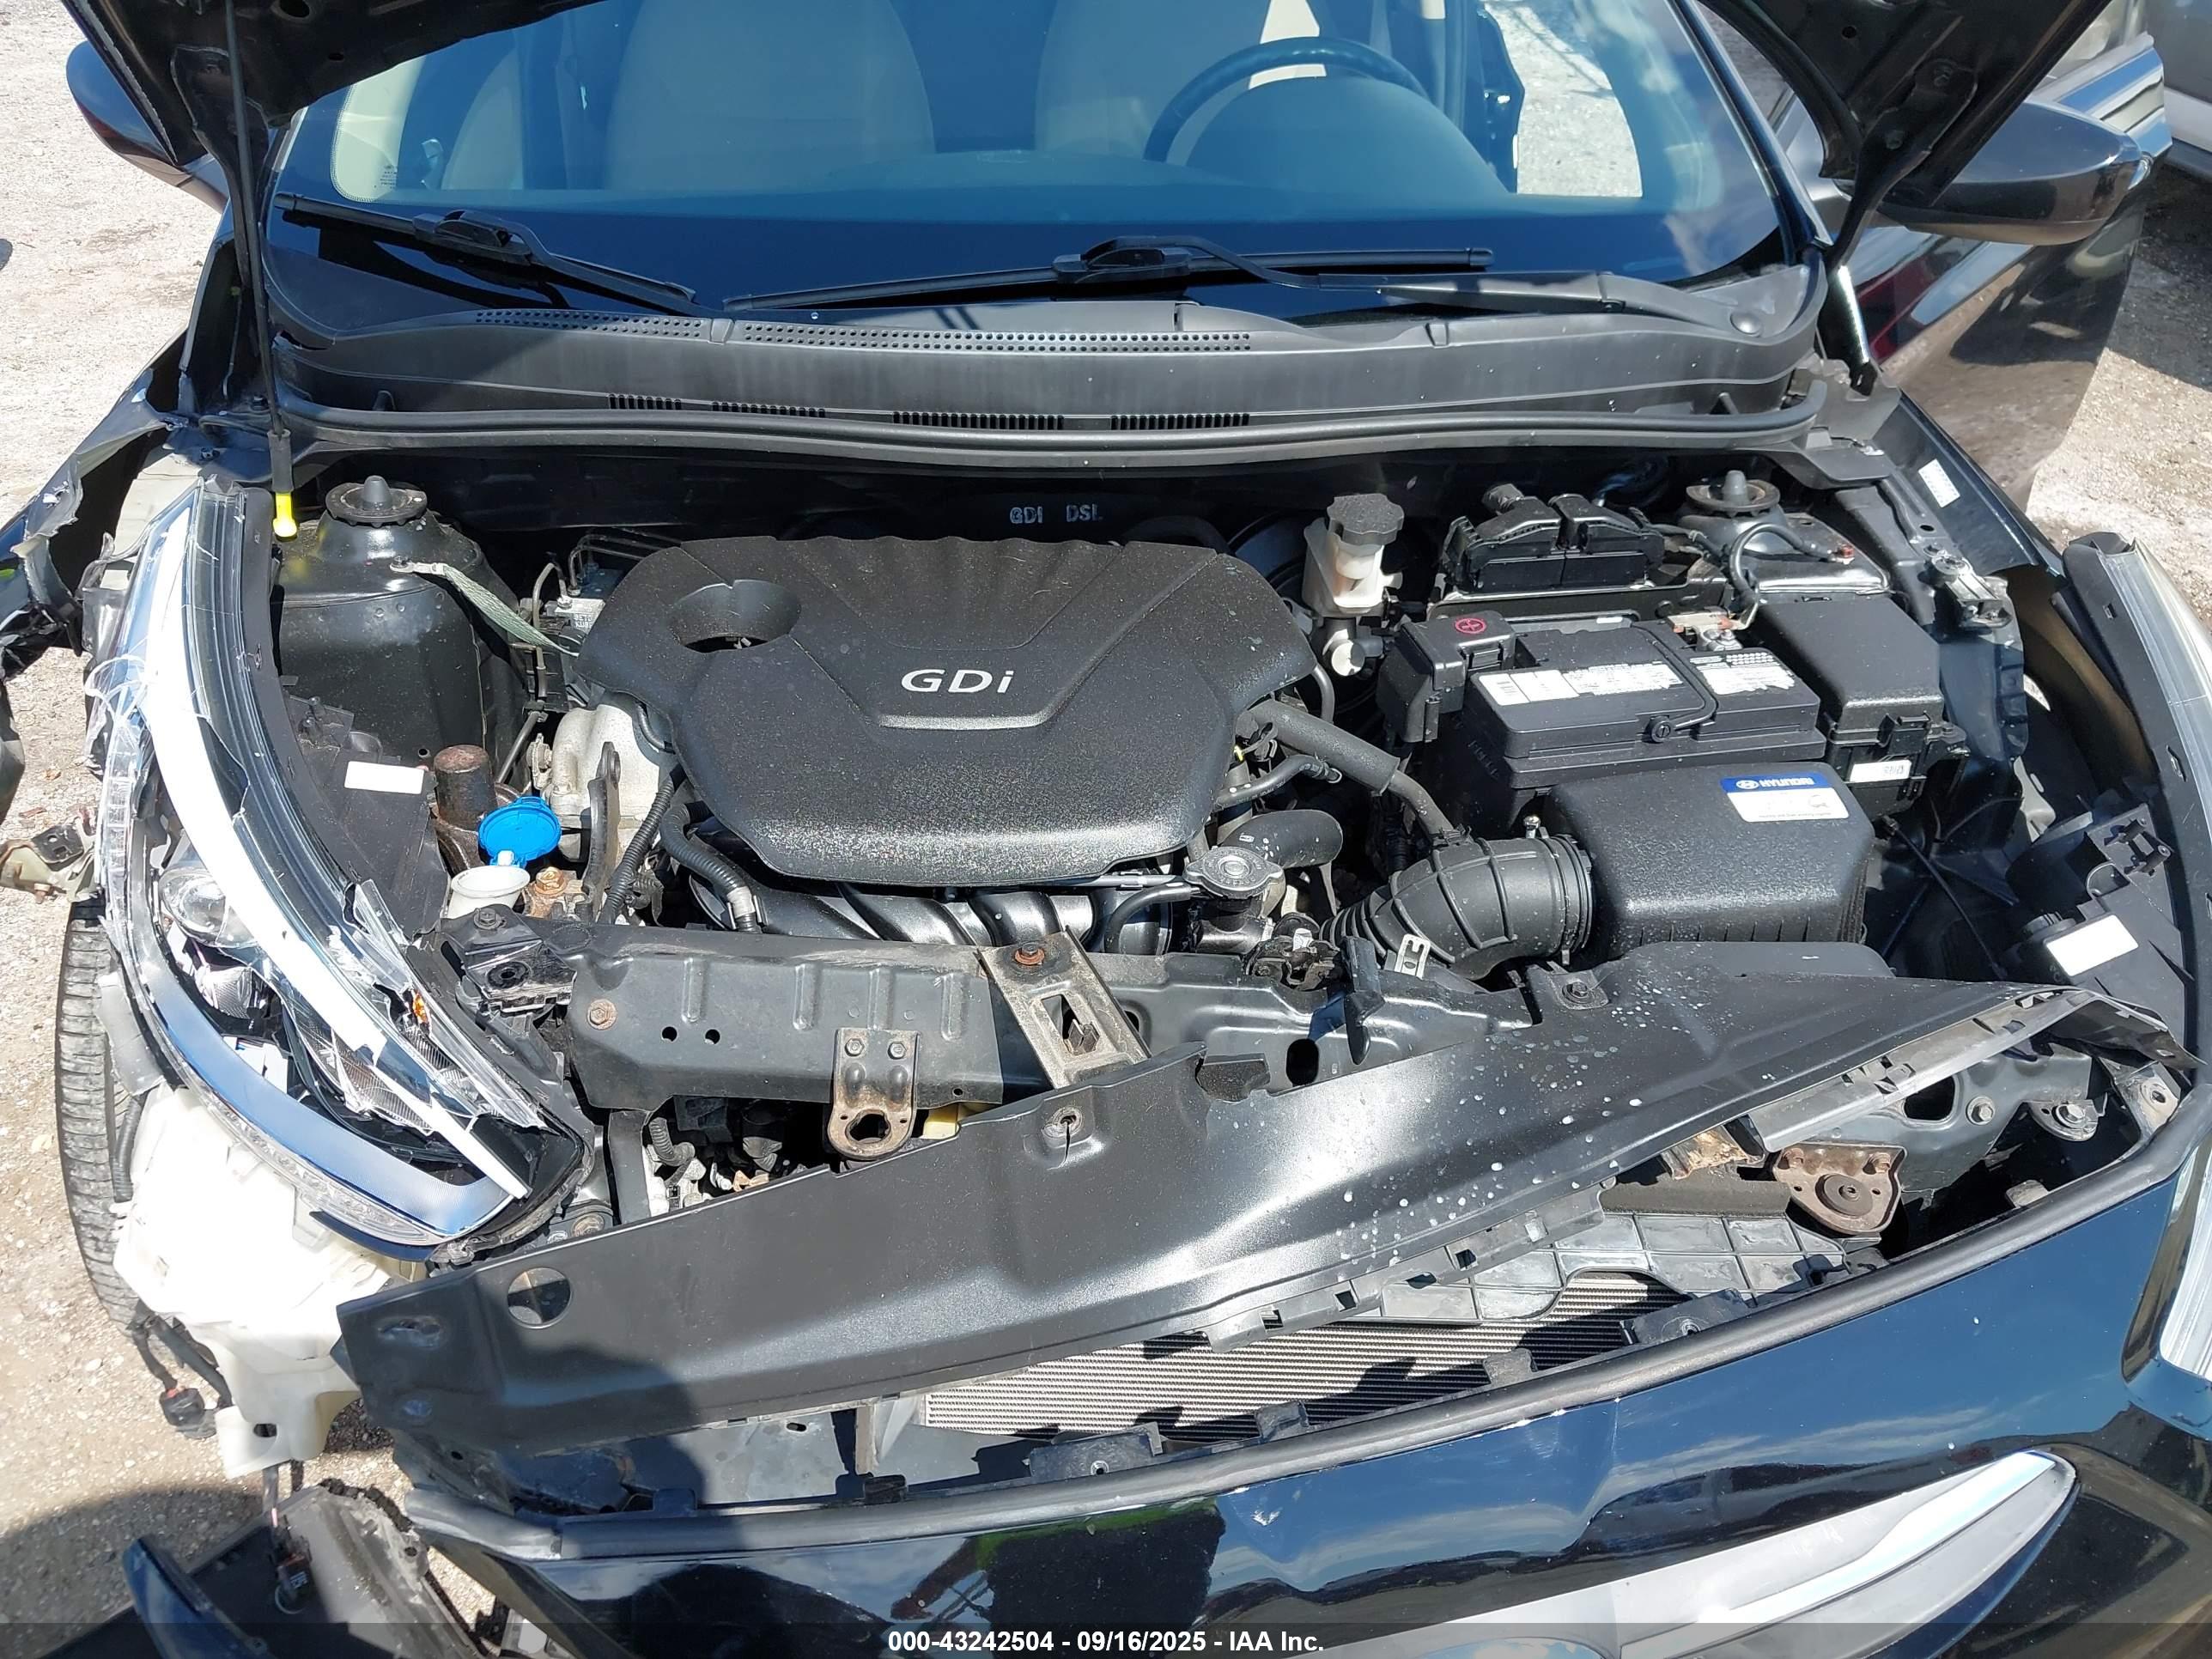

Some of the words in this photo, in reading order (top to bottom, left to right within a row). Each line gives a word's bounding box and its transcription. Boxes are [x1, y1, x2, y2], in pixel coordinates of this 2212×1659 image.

[1009, 505, 1043, 524] GDI
[901, 669, 1014, 693] GDi
[1759, 777, 1814, 788] HYUNDAI
